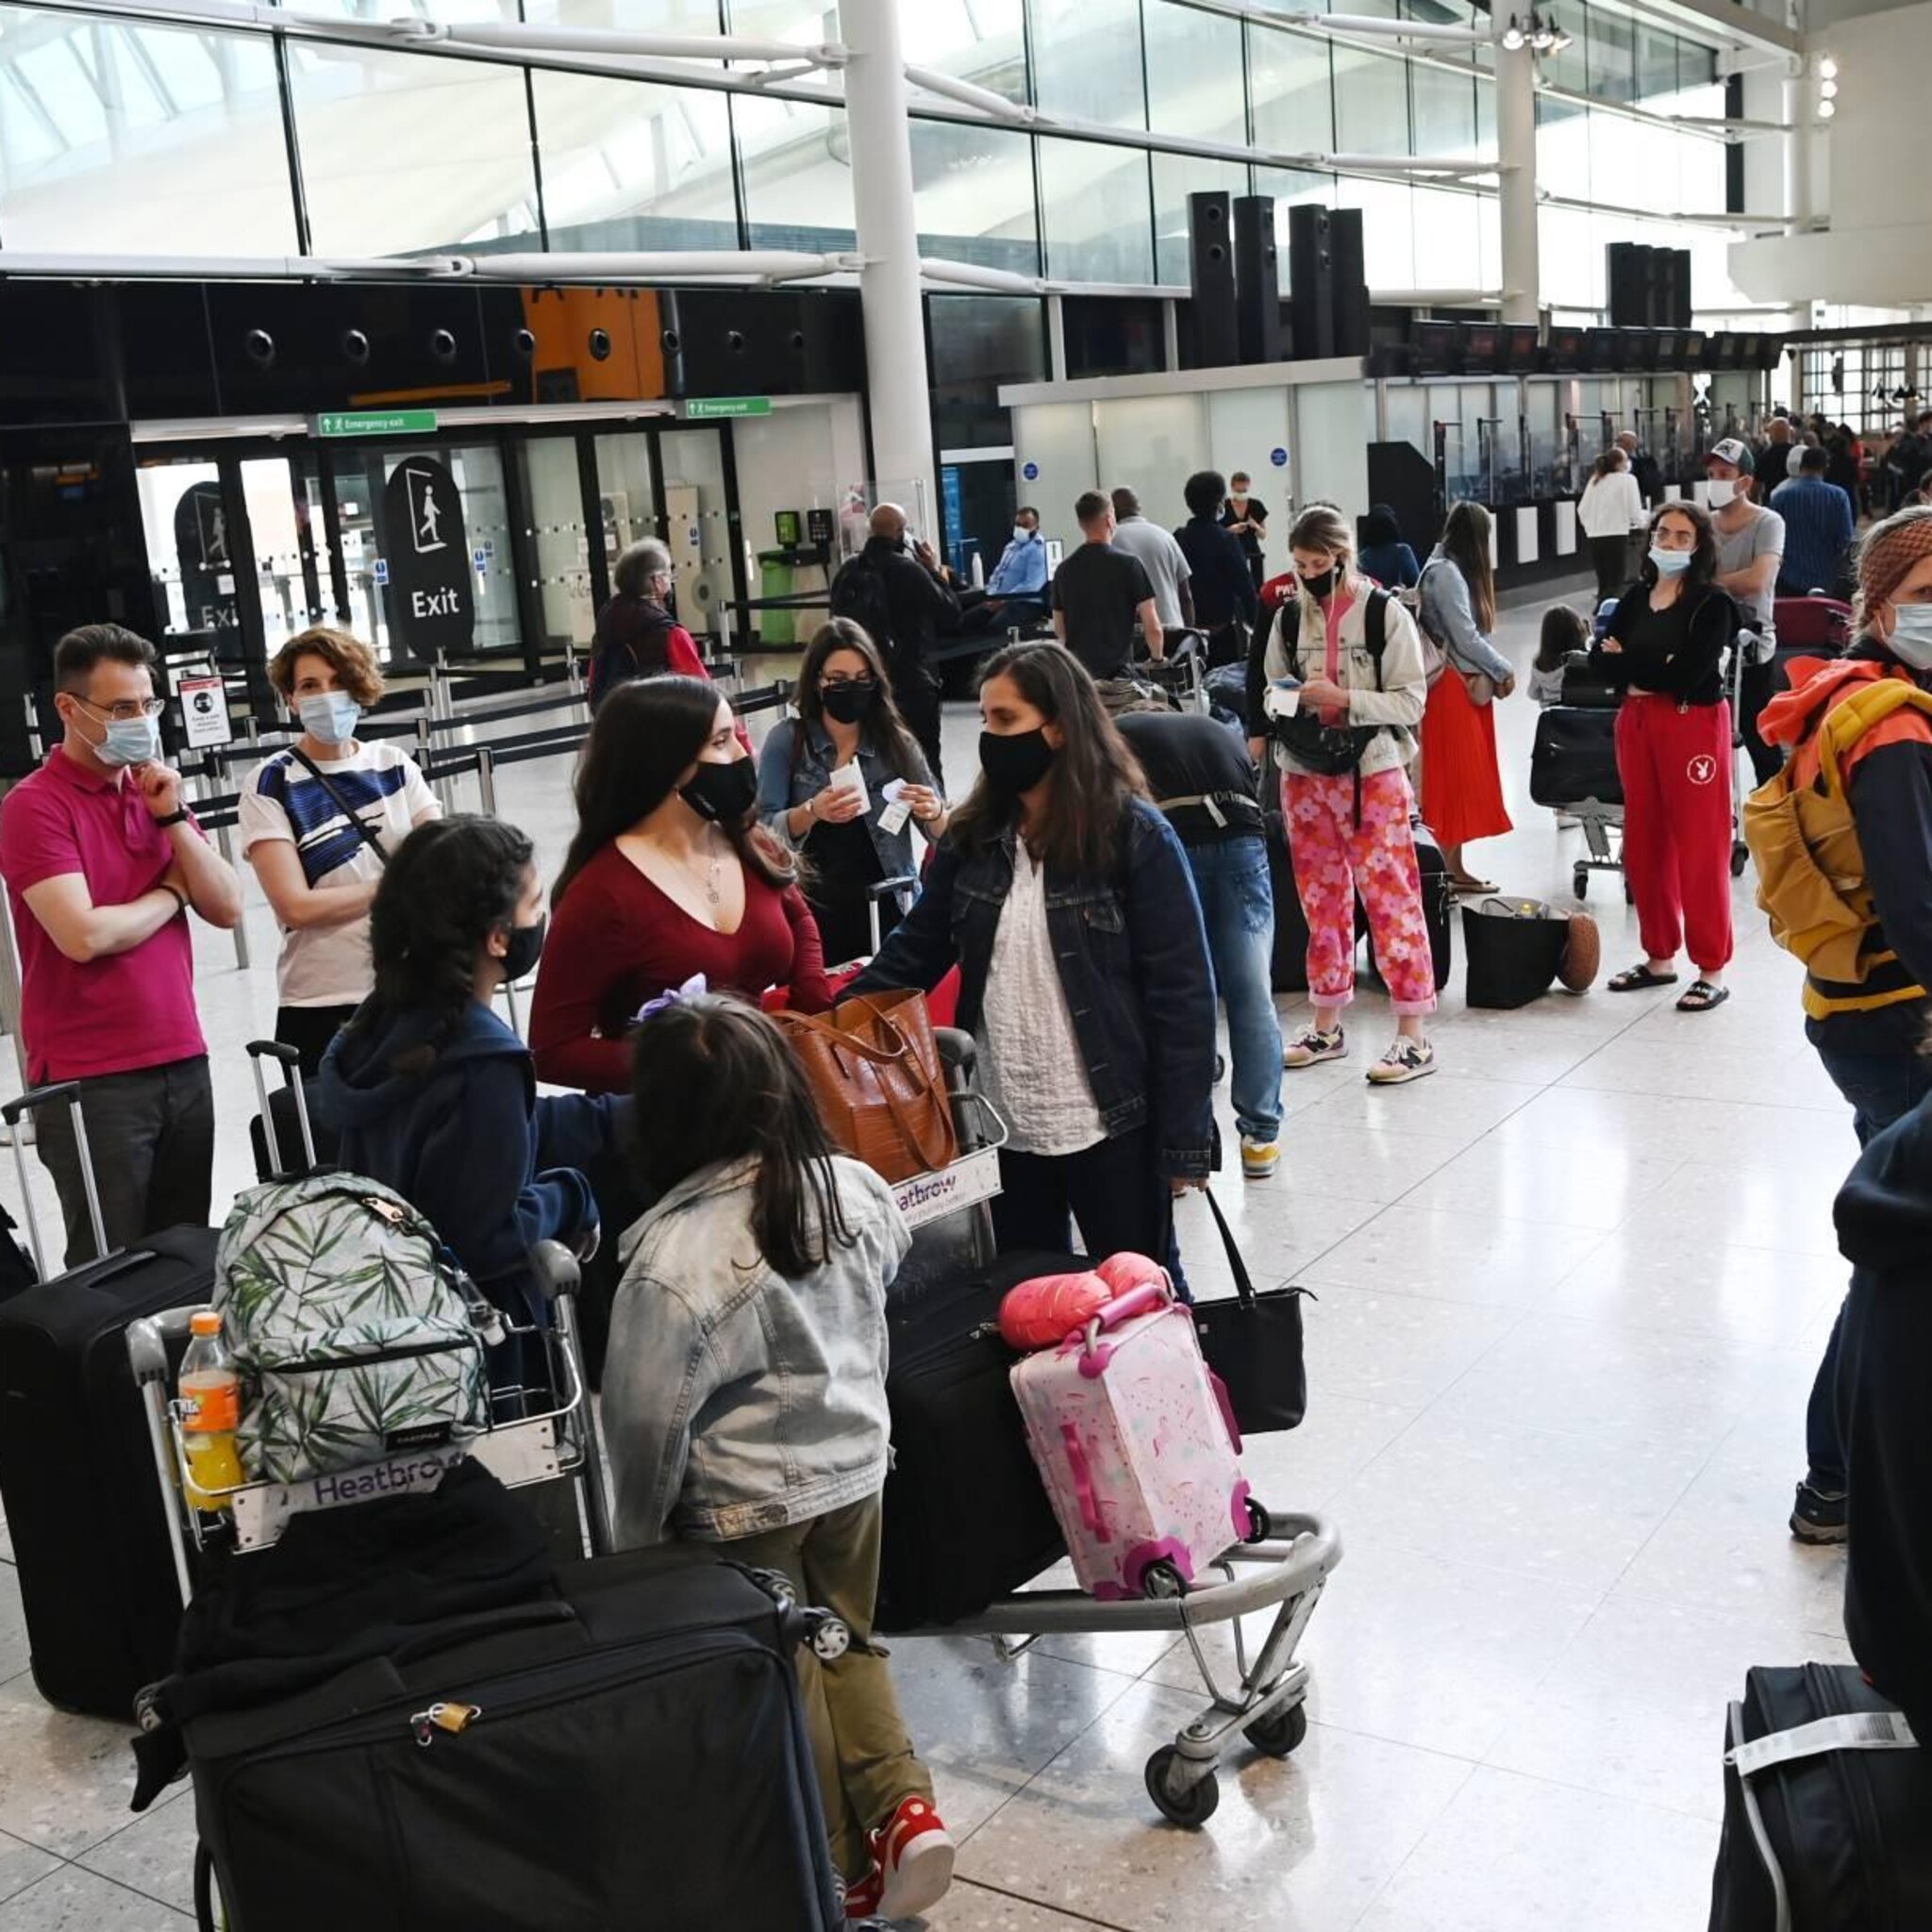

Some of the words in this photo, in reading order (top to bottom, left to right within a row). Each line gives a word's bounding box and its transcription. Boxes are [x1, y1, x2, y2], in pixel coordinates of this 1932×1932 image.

[344, 419, 388, 430] Emergency
[389, 418, 405, 426] exit
[411, 586, 460, 618] Exit
[896, 1175, 956, 1211] athrow
